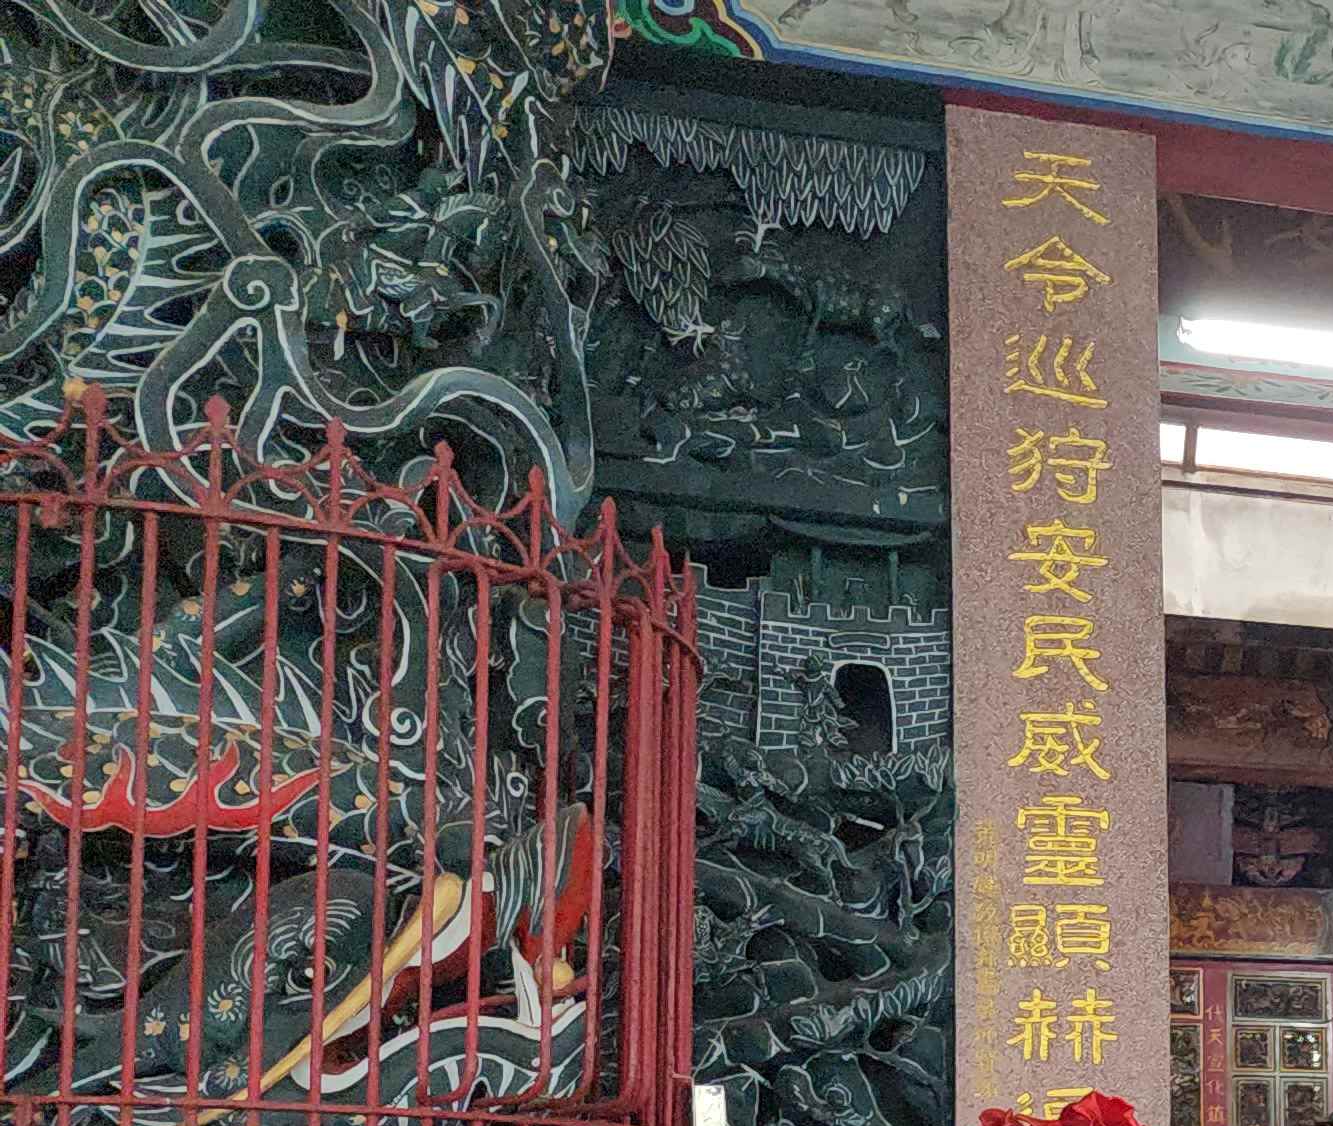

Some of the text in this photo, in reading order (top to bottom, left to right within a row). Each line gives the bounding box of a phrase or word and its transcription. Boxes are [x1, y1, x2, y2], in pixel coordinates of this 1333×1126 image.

[1000, 151, 1118, 1120] 天令巡狩安民威靈顯赫
